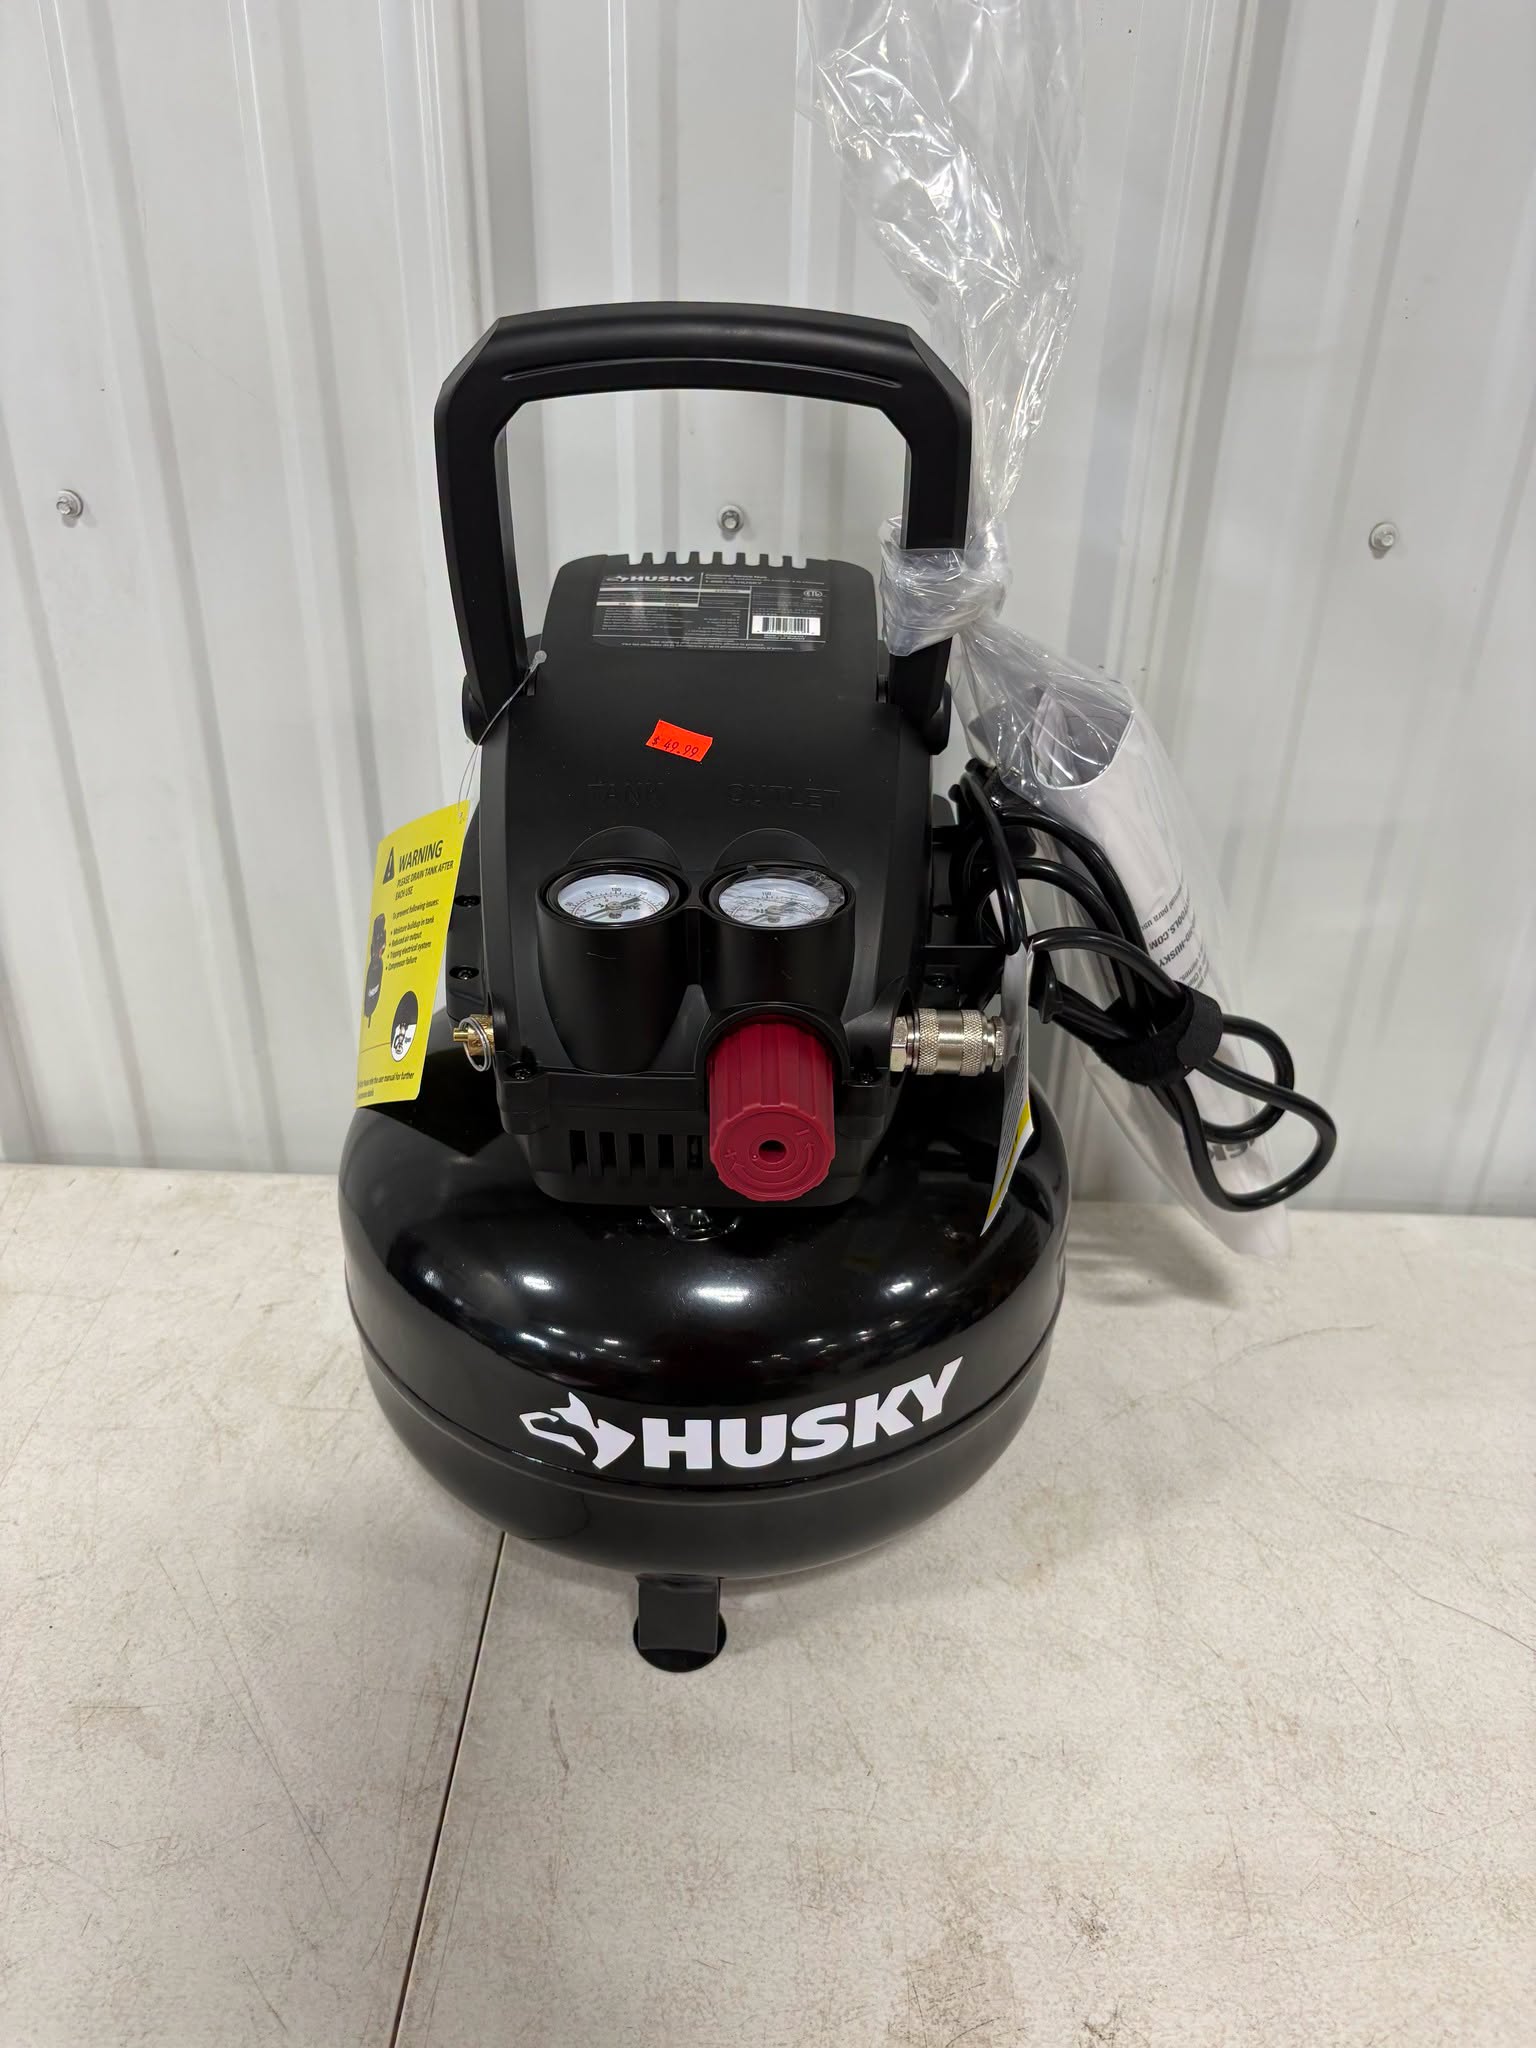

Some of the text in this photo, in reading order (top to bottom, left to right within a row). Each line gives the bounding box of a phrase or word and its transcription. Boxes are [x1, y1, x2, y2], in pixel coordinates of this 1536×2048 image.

[629, 575, 695, 583] HUSKY
[651, 735, 699, 757] $ 49.99
[586, 782, 664, 806] TANK
[727, 783, 840, 808] OUTLET
[398, 839, 444, 873] WARNING
[397, 860, 454, 888] PLEASE DRAIN TANK AFTER
[395, 886, 414, 900] EACH USE
[396, 905, 410, 920] prevent
[408, 901, 427, 915] following
[425, 899, 439, 909] issues:
[1152, 904, 1169, 923] para
[393, 923, 408, 935] Moisture
[406, 918, 421, 932] buildup
[424, 916, 434, 925] tank
[1149, 904, 1190, 950] TOOLS.COM
[391, 936, 406, 948] Reduced
[409, 932, 422, 942] output
[1158, 924, 1195, 968] HD-HUSKY
[389, 942, 431, 960] Tripping electrical system
[405, 956, 417, 966] failure
[642, 1356, 963, 1470] HUSKY
